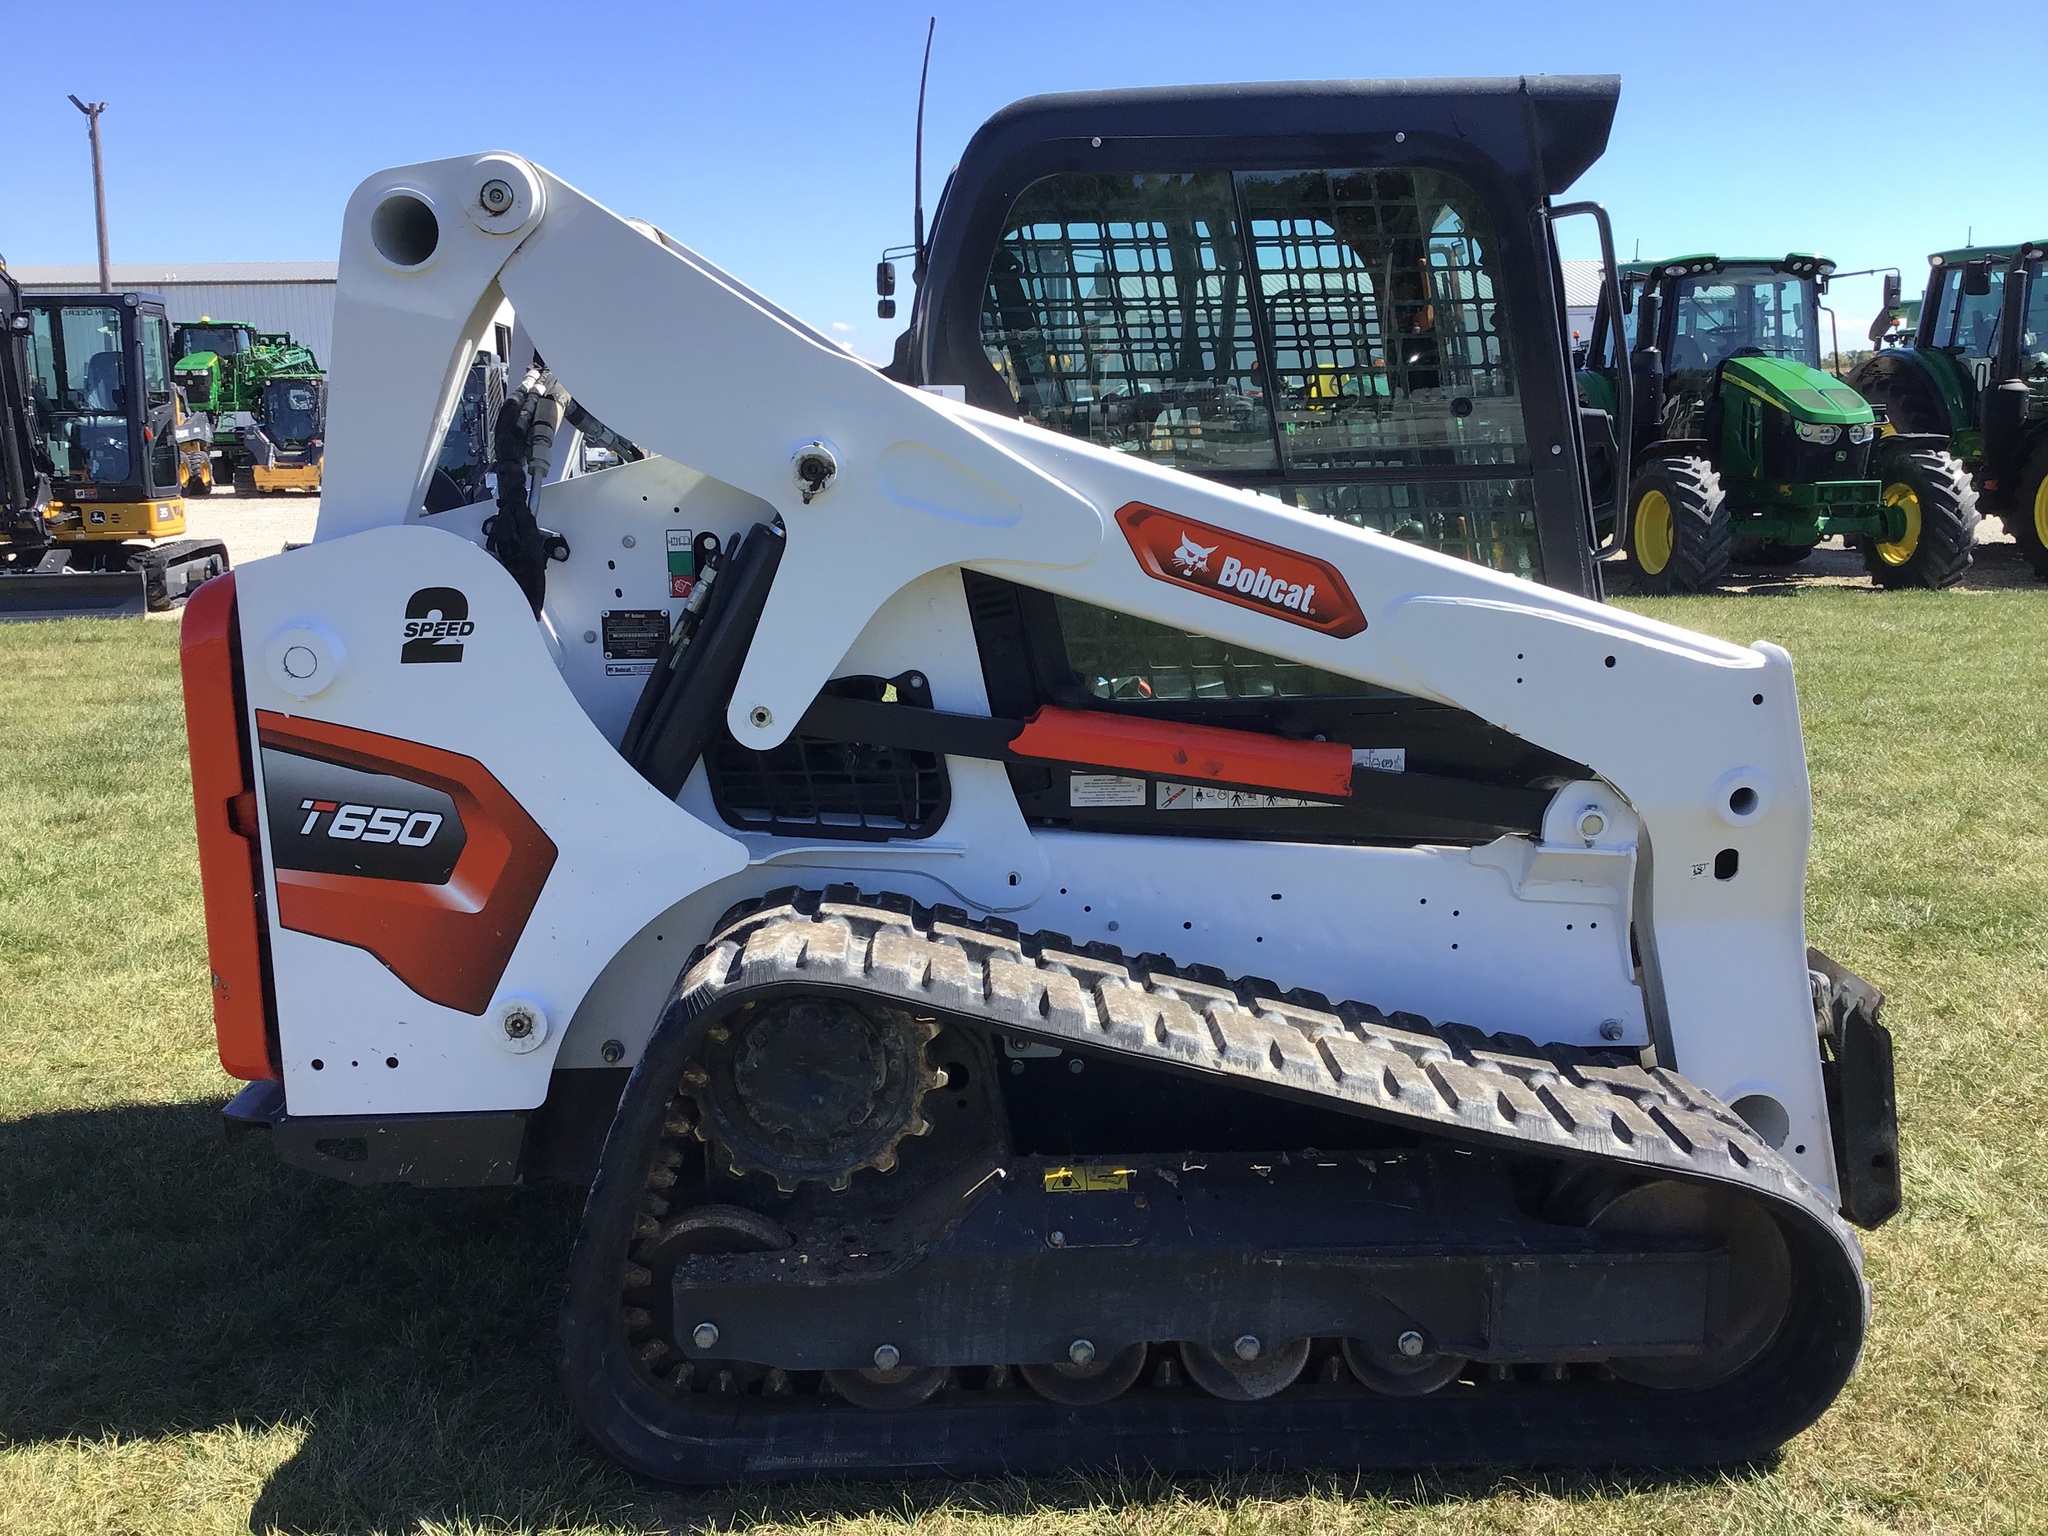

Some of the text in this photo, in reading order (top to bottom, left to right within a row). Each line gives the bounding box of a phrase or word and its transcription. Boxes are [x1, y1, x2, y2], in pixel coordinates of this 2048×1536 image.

[1217, 556, 1316, 614] Bobcat
[400, 586, 469, 664] 2
[403, 621, 475, 637] SPEED
[300, 799, 444, 848] T650
